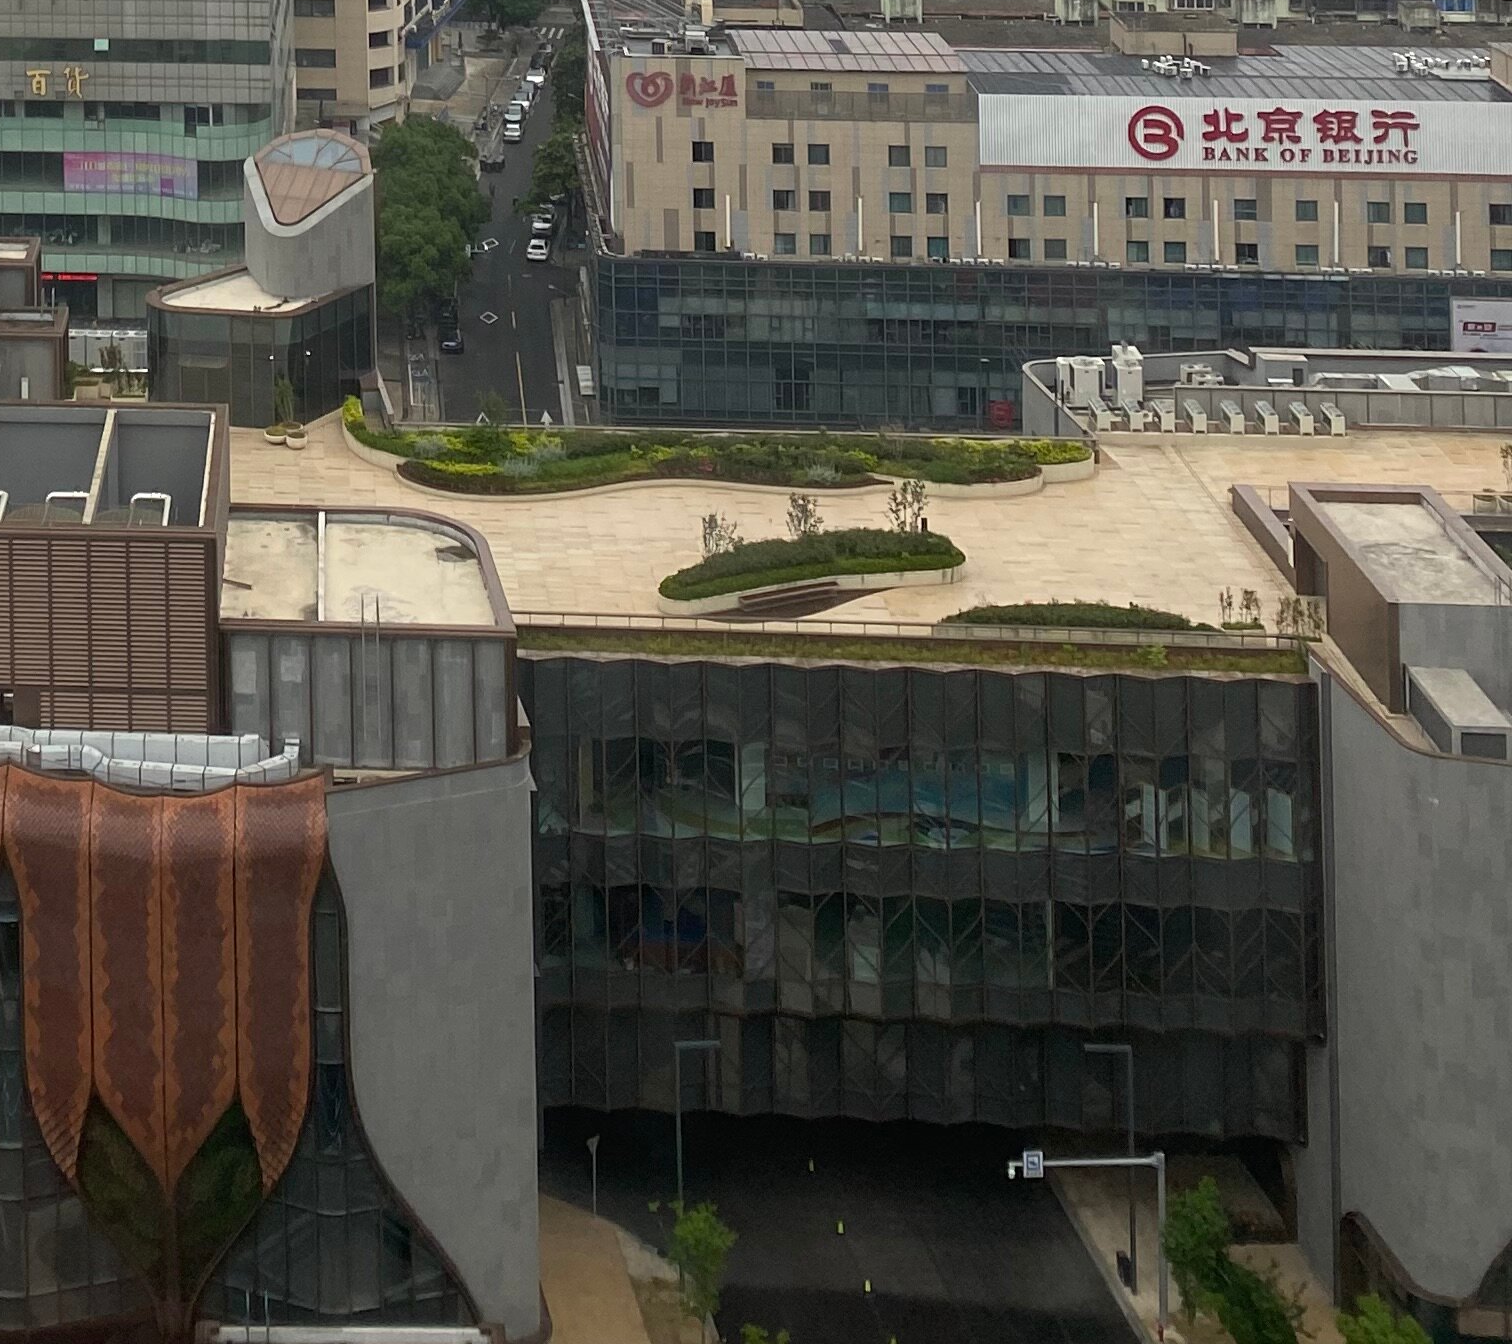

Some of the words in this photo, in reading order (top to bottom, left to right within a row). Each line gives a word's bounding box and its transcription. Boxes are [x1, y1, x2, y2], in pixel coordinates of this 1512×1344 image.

[1201, 106, 1421, 148] 北京银行
[1202, 146, 1269, 163] BANK
[1279, 148, 1313, 163] OF
[1322, 148, 1419, 165] BEIJING
